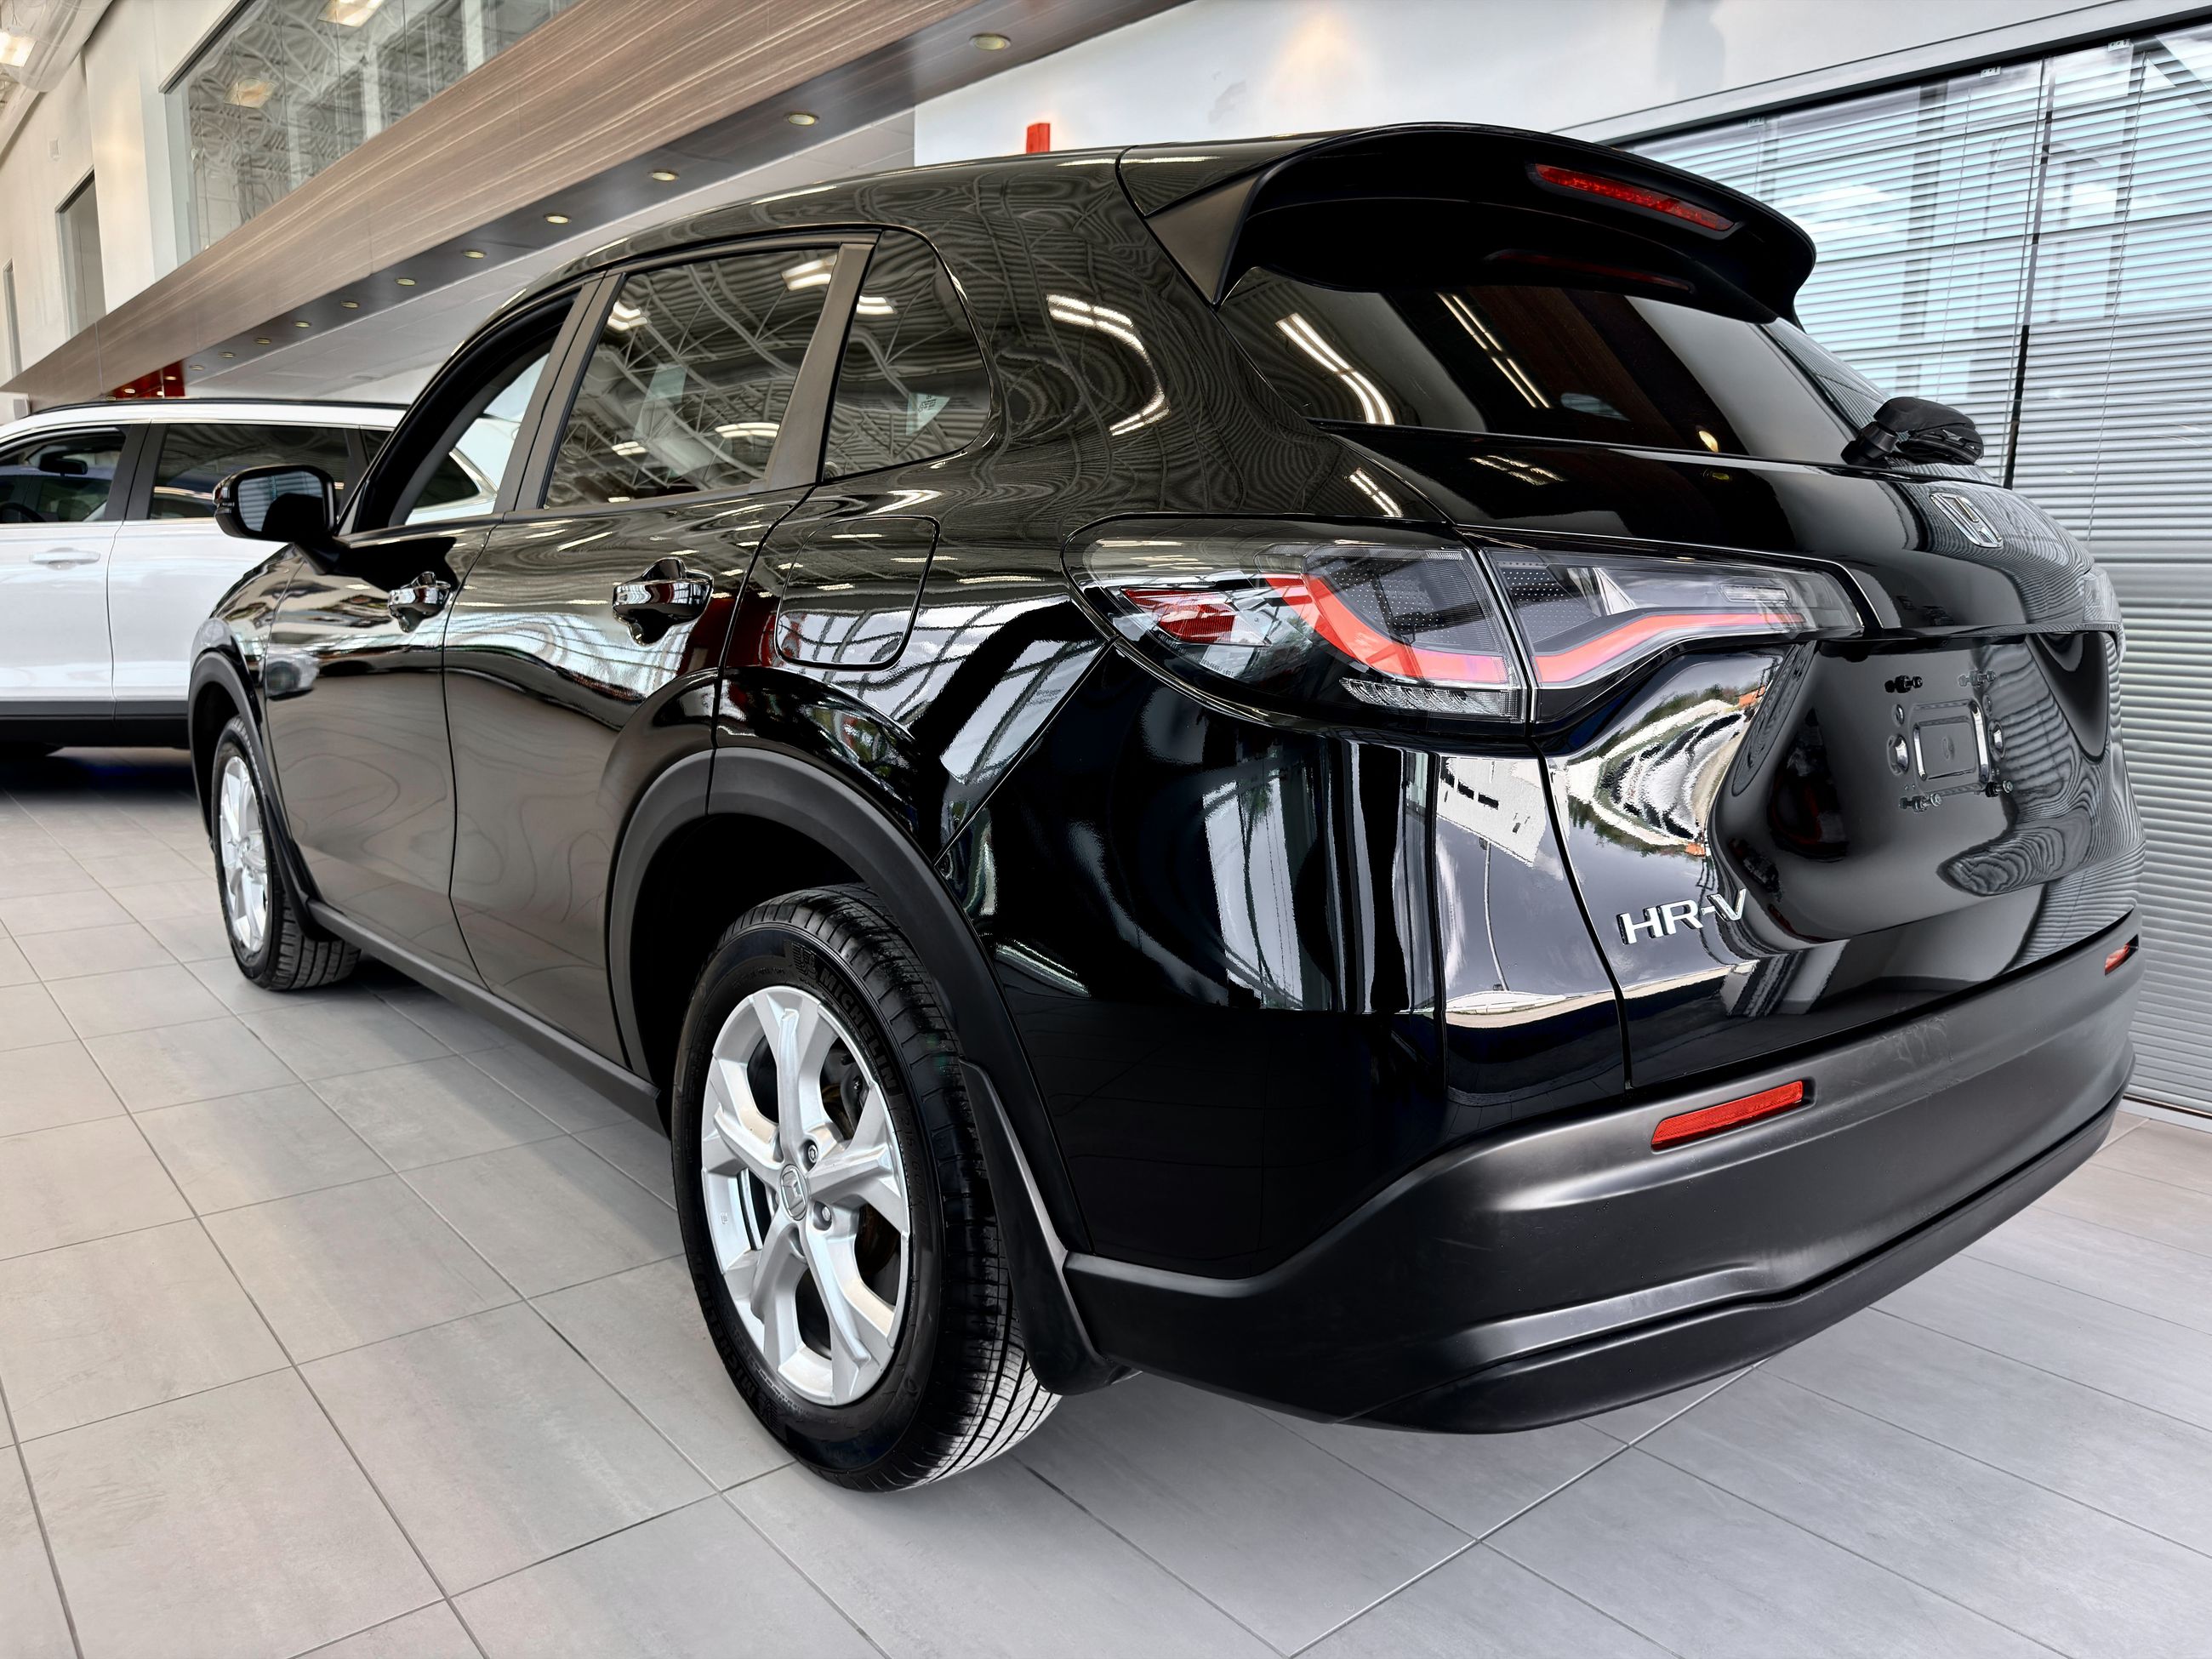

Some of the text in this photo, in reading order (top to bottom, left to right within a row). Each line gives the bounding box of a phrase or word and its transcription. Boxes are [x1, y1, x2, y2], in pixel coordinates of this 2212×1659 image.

[1616, 888, 1747, 945] HR-V
[818, 967, 899, 1090] MICHELIN
[696, 1276, 757, 1400] MICHELIN
